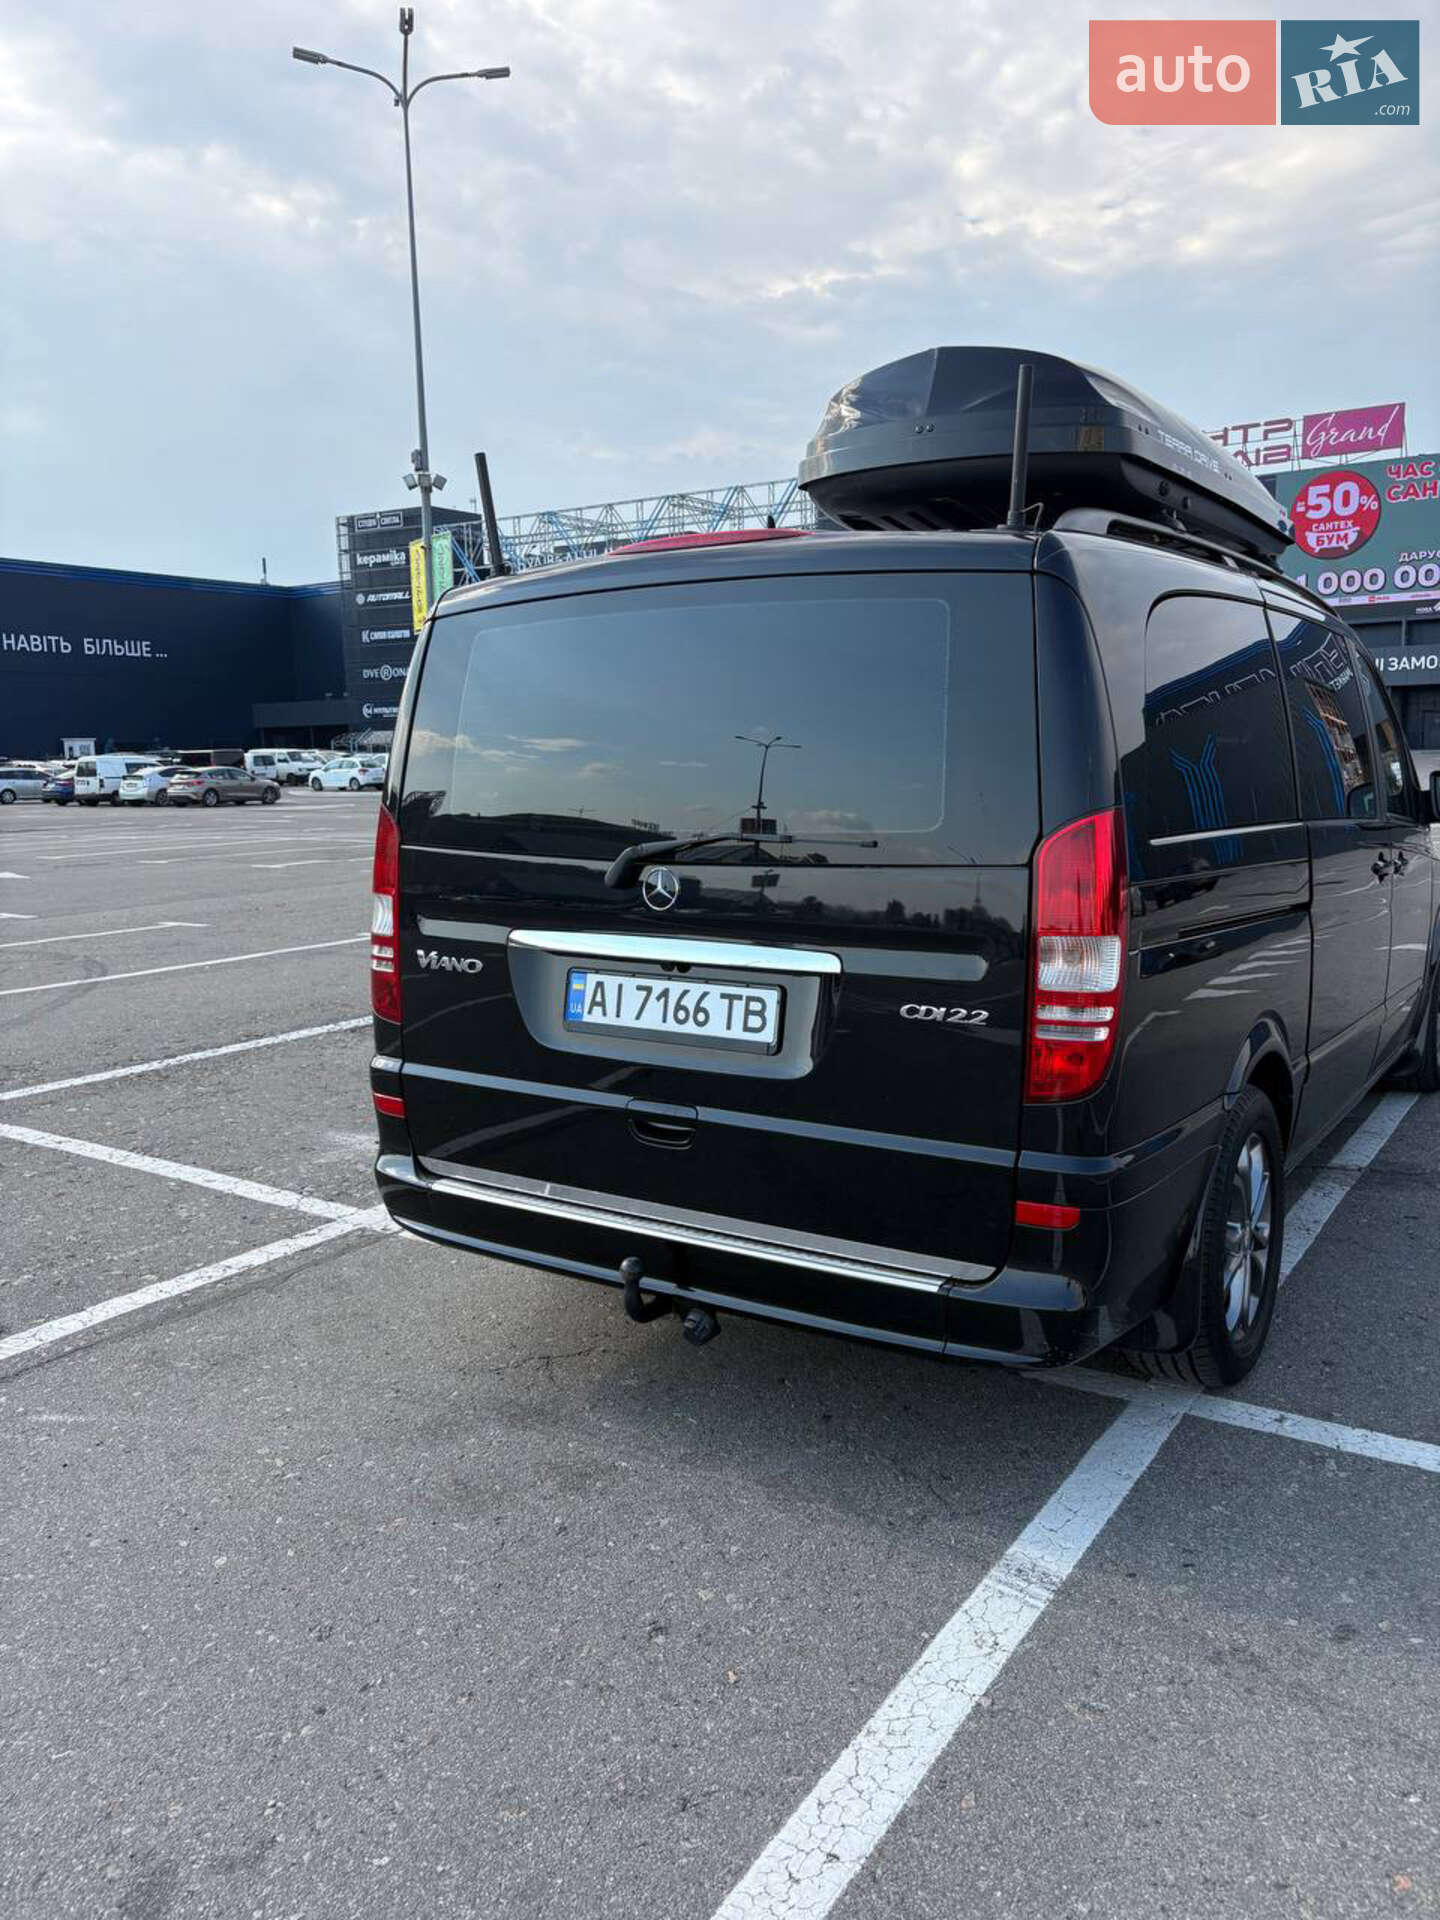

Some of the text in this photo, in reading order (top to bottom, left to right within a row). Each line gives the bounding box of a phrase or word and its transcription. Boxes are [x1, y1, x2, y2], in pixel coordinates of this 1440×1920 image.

[1306, 404, 1400, 459] Grand
[1386, 460, 1435, 481] ЧАС
[1312, 519, 1354, 532] САНТЕХ
[1316, 533, 1349, 547] БУМ
[1317, 567, 1386, 595] 000
[2, 632, 72, 654] НАВІТЬ
[1387, 654, 1440, 672] ЗАМО
[570, 980, 768, 1034] UA AI 7166 TB
